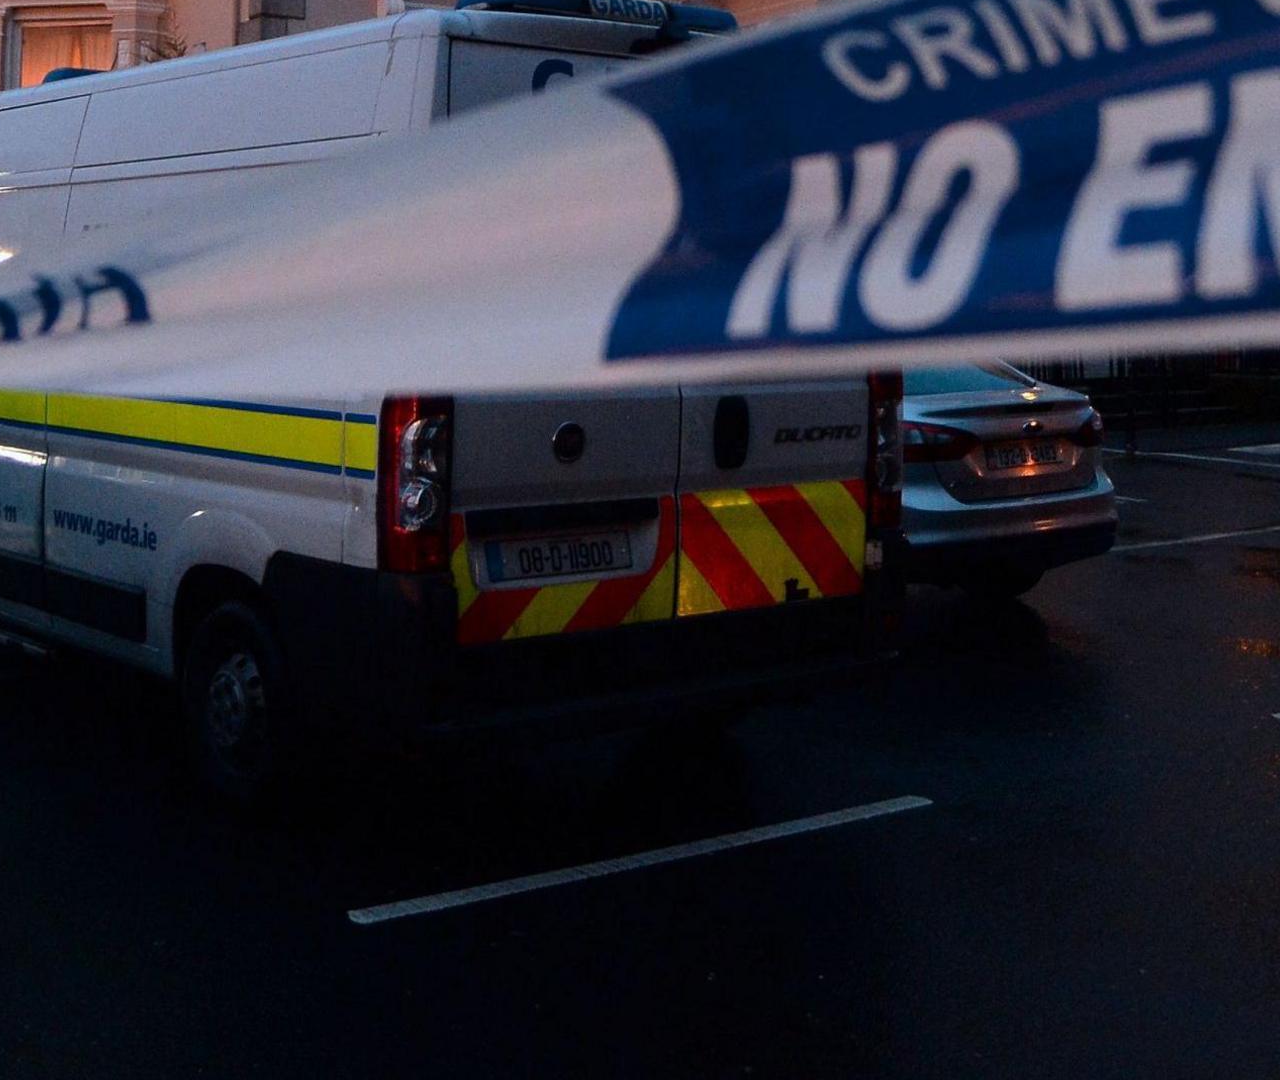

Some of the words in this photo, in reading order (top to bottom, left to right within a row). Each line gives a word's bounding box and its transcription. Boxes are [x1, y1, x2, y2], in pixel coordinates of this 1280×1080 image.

[727, 123, 1020, 337] NO
[774, 424, 861, 442] DUCATO
[54, 509, 158, 552] www.garda.ie
